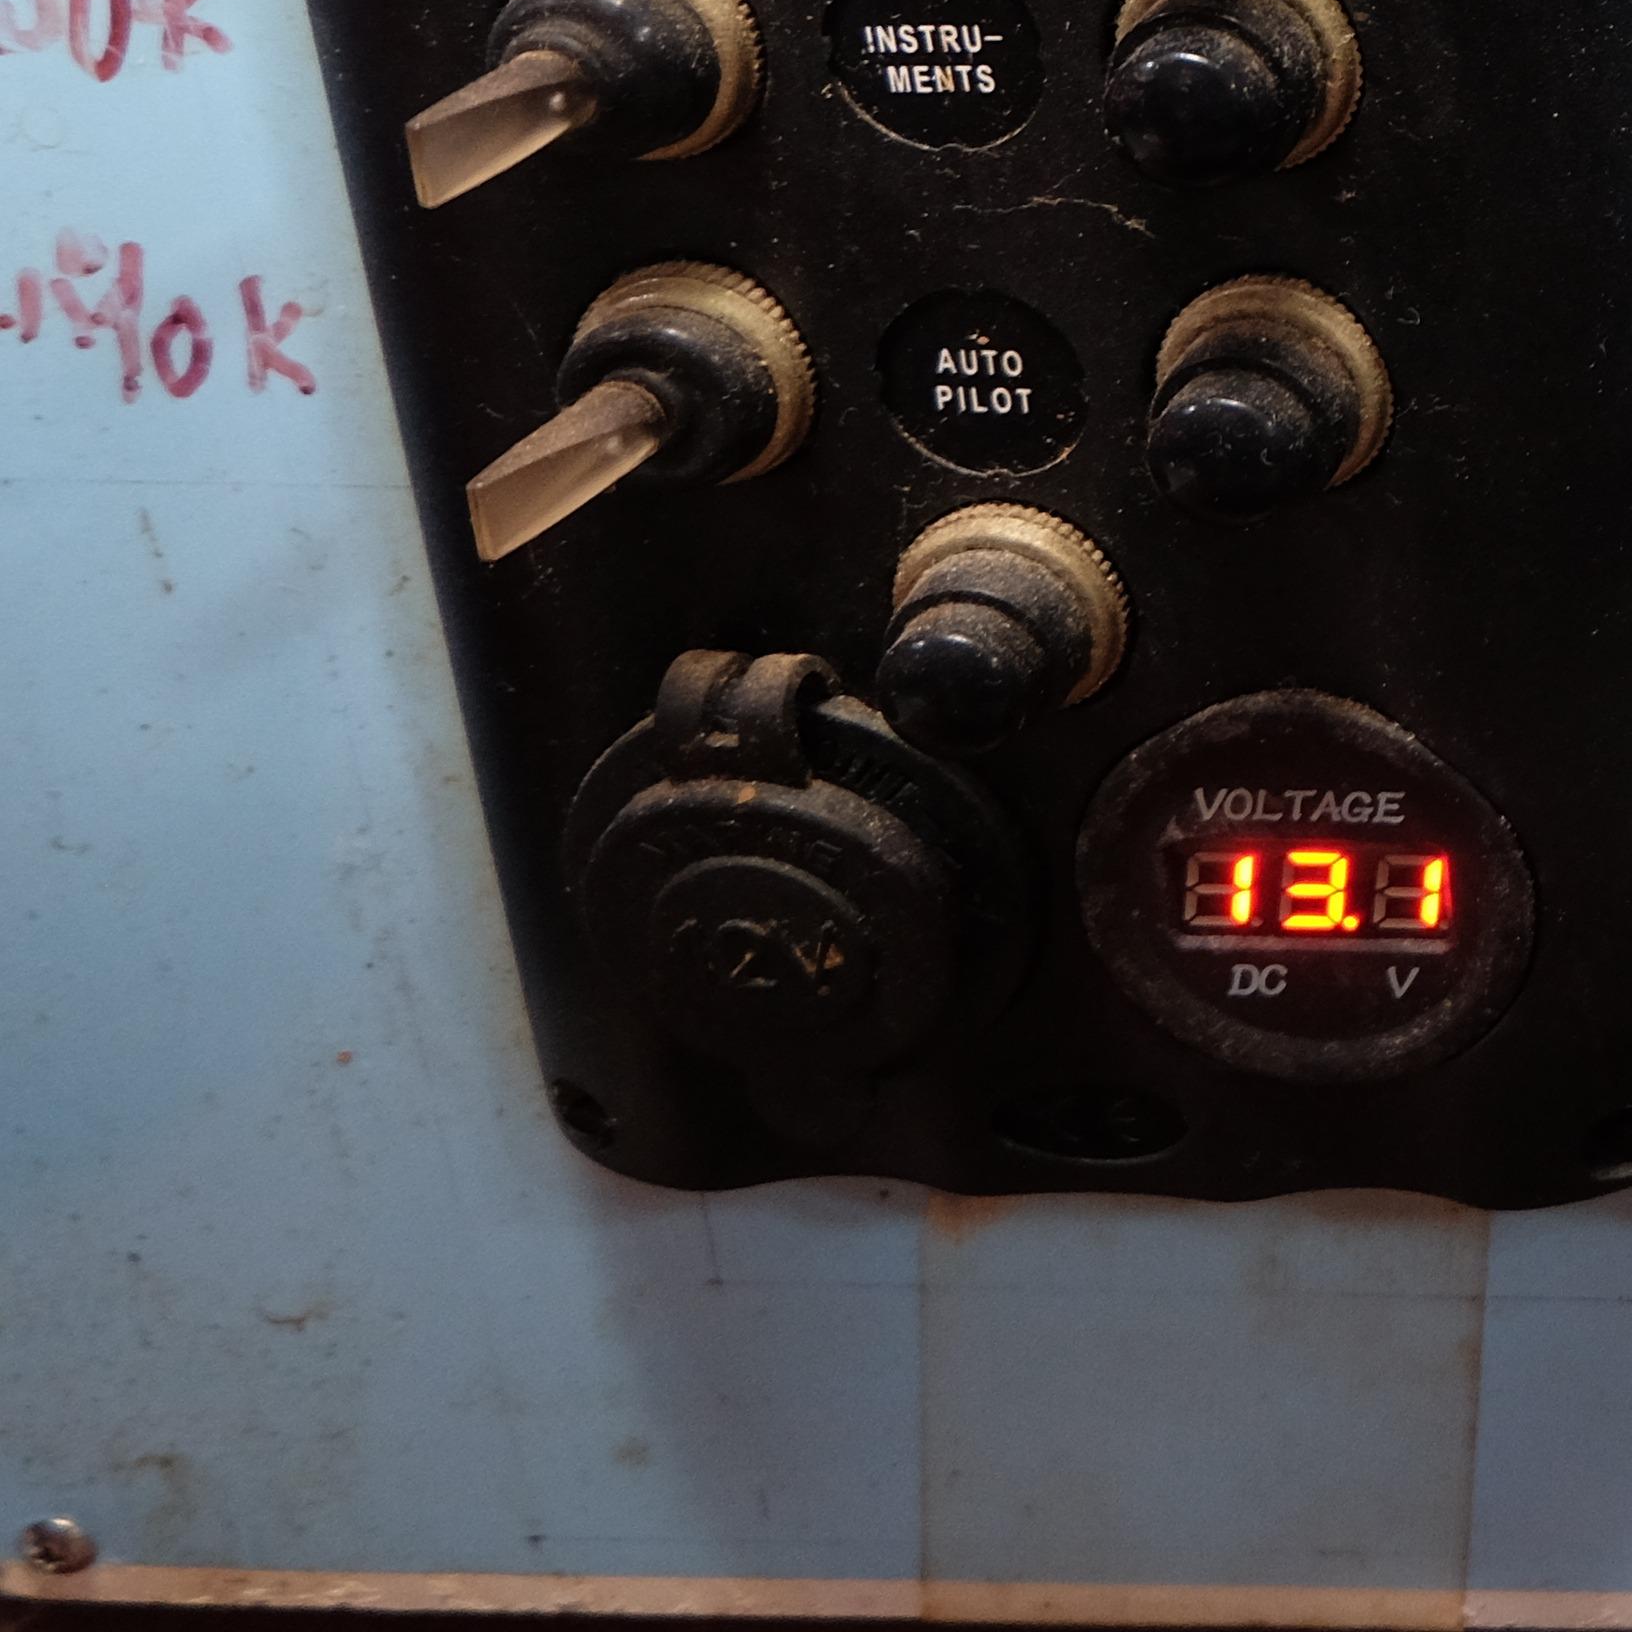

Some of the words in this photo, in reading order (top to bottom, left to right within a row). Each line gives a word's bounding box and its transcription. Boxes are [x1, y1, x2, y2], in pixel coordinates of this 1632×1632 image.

[862, 23, 1004, 55] INSTRU-
[886, 63, 997, 95] MENTS
[936, 347, 1024, 378] AUTO
[934, 383, 1033, 415] PILOT
[1193, 786, 1408, 827] VOLTAGE
[1220, 848, 1450, 933] 13.1
[1227, 963, 1288, 998] DC
[1386, 965, 1420, 999] V
